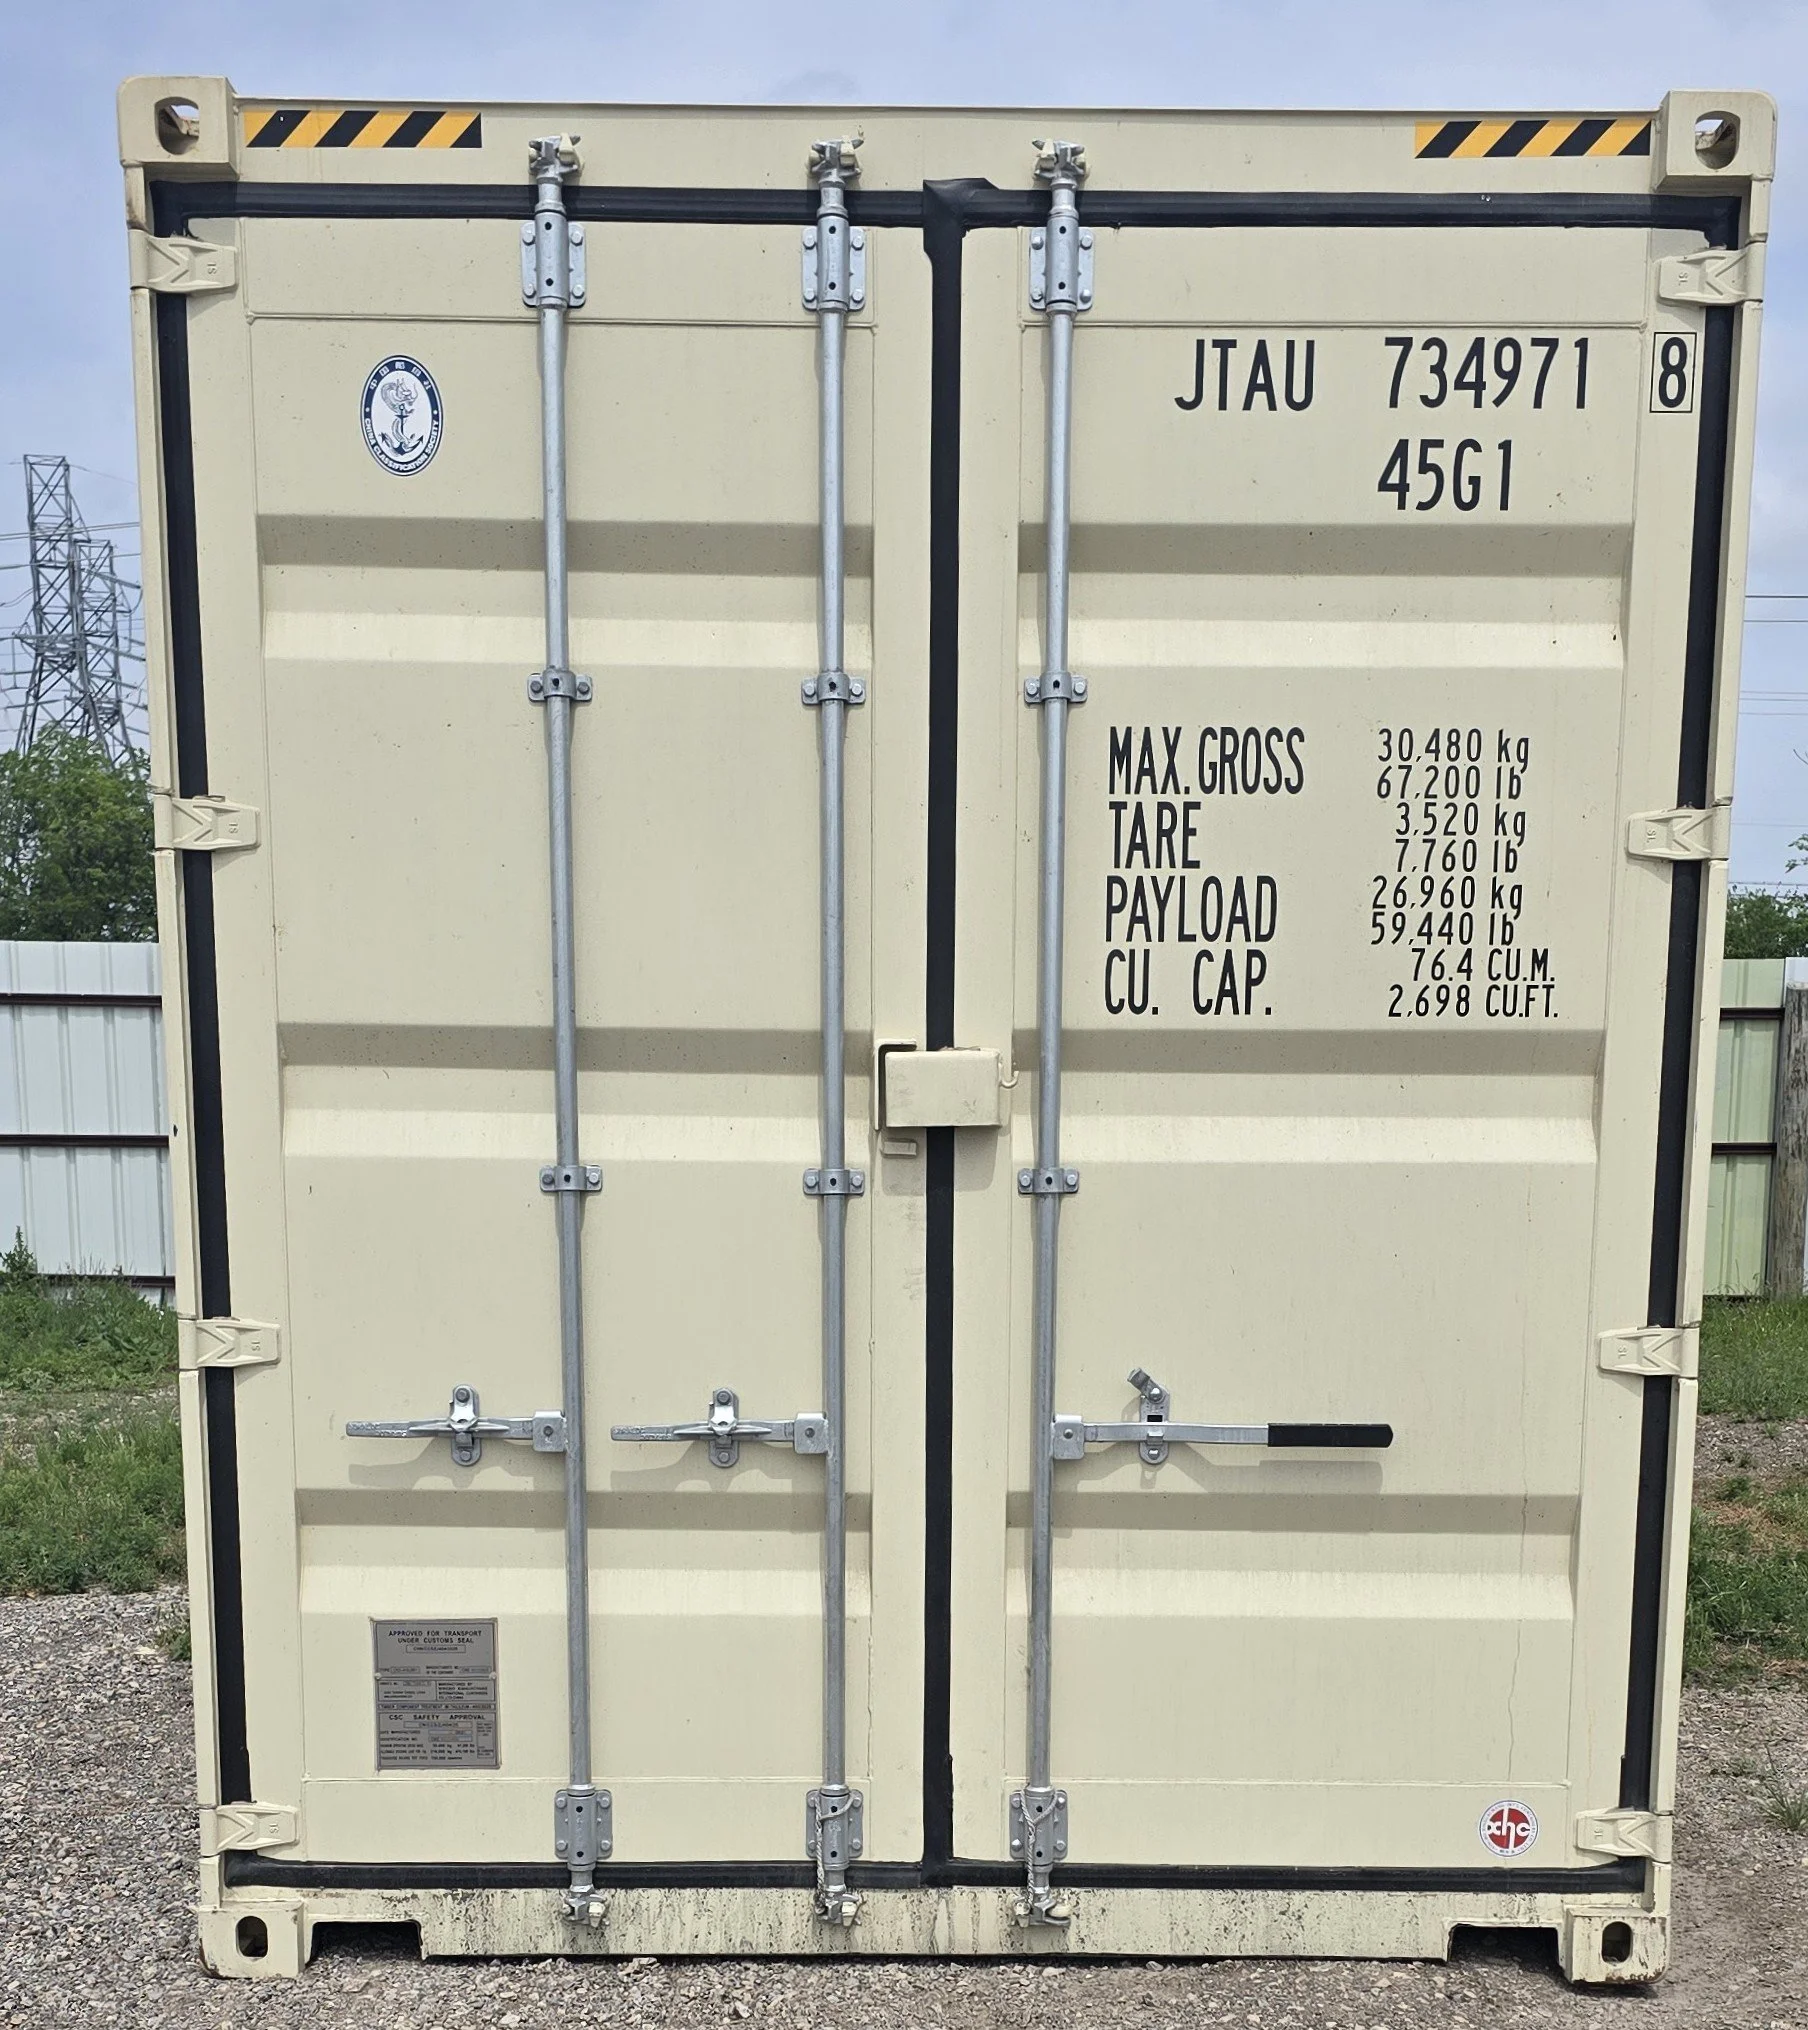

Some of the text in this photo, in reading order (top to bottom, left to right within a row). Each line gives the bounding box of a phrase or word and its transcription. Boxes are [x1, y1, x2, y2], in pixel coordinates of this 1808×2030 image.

[1174, 336, 1688, 412] JTAU 734971 8
[373, 444, 428, 471] CLASSIFICATION
[1377, 438, 1512, 511] 45G1
[1377, 728, 1529, 773] 30,480 kg
[1376, 765, 1521, 799] 67,200 lb
[1109, 801, 1202, 869] TARE
[1395, 802, 1526, 848] 3,520 kg
[1395, 839, 1518, 873] 7,760 lb
[1105, 875, 1277, 943] PAYLOAD
[1372, 876, 1522, 920] 26,960 kg
[1370, 911, 1514, 946] 59,440 lb
[1105, 949, 1272, 1016] CU. CAP.
[1411, 948, 1555, 982] 76.4 CU.M.
[1388, 984, 1559, 1018] 2,698 CU.FT.
